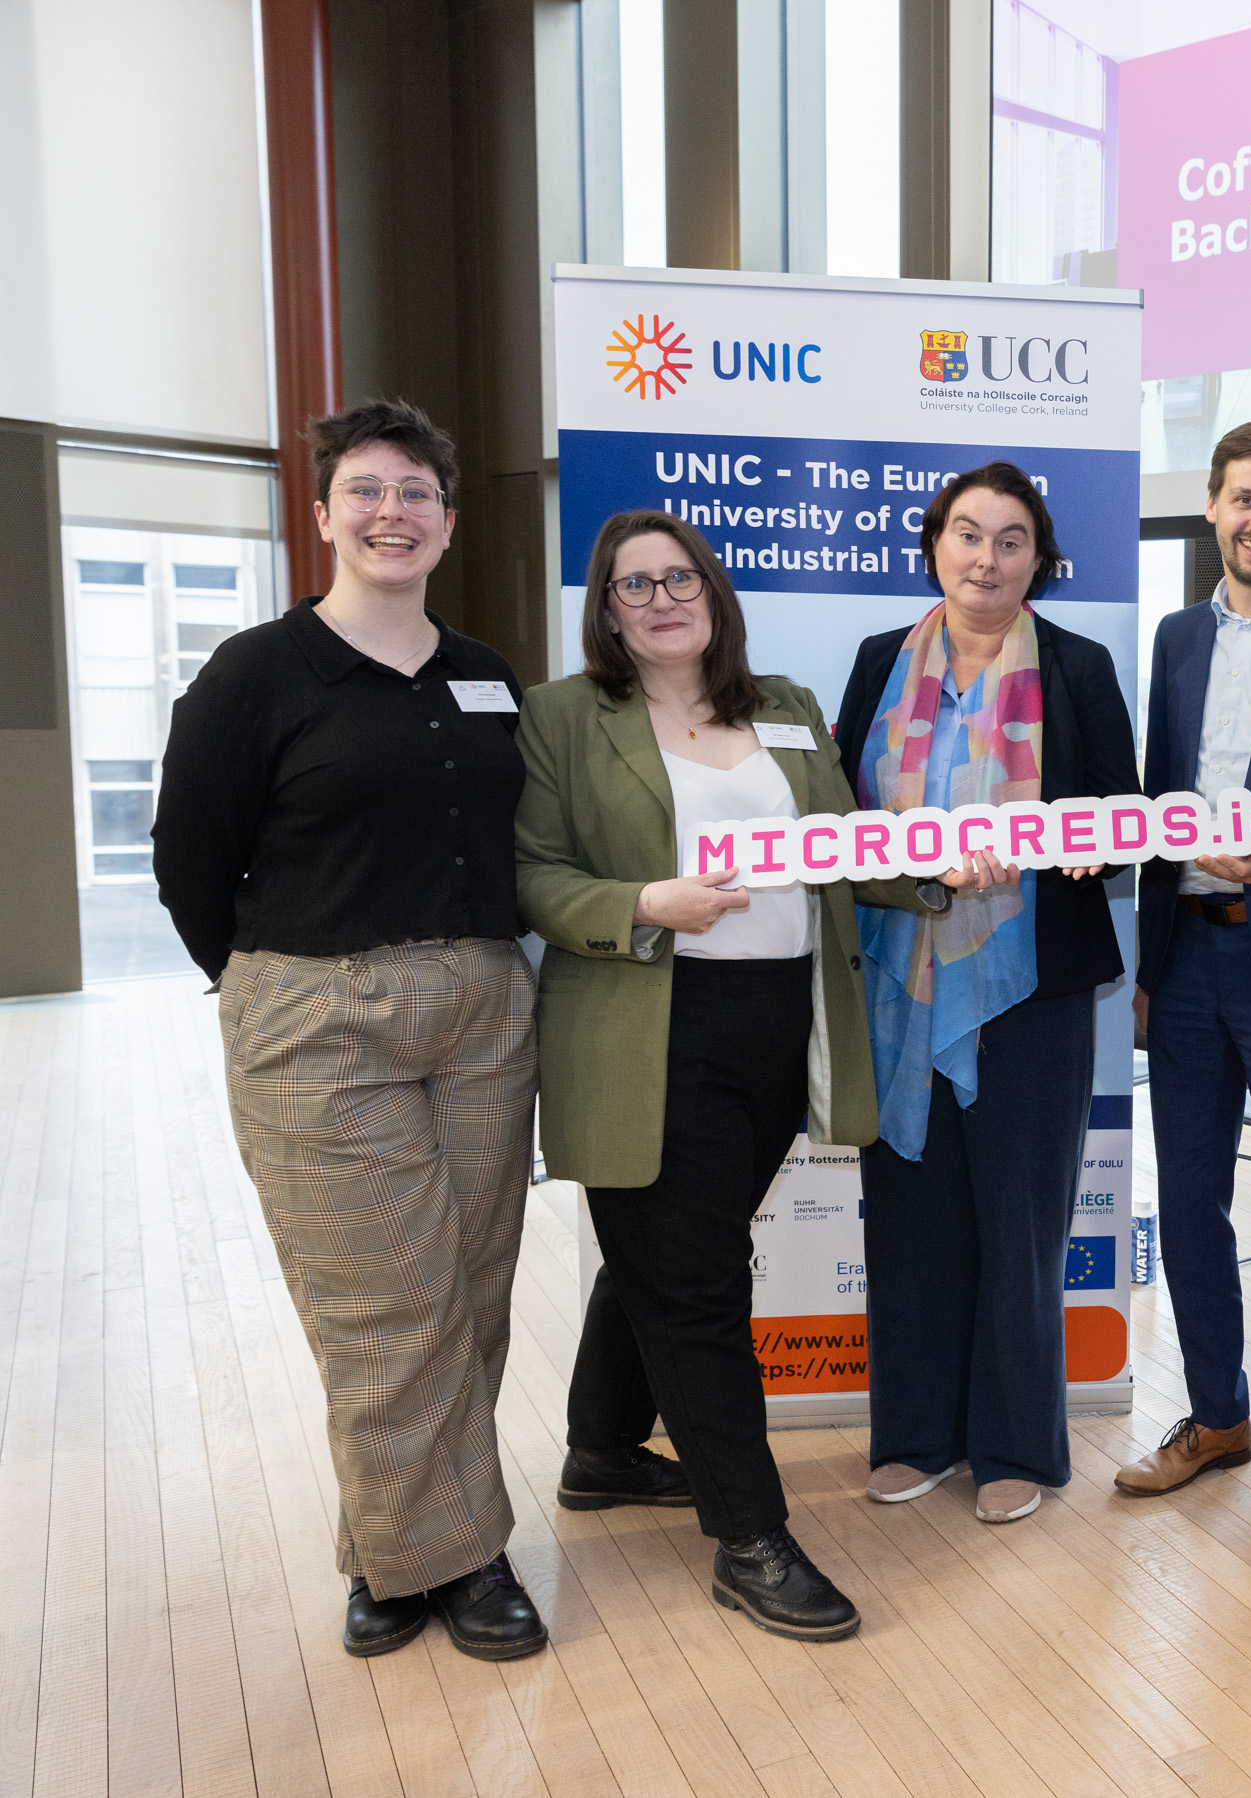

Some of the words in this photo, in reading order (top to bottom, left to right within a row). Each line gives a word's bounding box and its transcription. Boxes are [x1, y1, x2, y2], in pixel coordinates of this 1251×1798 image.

[713, 340, 822, 384] UNIC
[977, 335, 1089, 385] UCC
[920, 387, 963, 398] Coláiste
[967, 391, 980, 399] na
[983, 390, 1037, 401] hOllscoile
[1040, 393, 1089, 404] Corcaigh
[920, 401, 974, 413] University
[977, 403, 1018, 415] College
[1021, 405, 1049, 416] Cork,
[1052, 406, 1089, 417] Ireland
[656, 452, 762, 486] UNIC
[776, 468, 791, 477] -
[805, 461, 871, 489] The
[664, 498, 843, 536] University
[855, 505, 891, 532] of
[1084, 1160, 1096, 1168] OF
[1098, 1160, 1124, 1168] OULU
[794, 1206, 844, 1214] UNIVERSITÄT
[794, 1214, 828, 1222] BOCHUM
[1136, 1229, 1148, 1283] WATER
[837, 1280, 853, 1293] of
